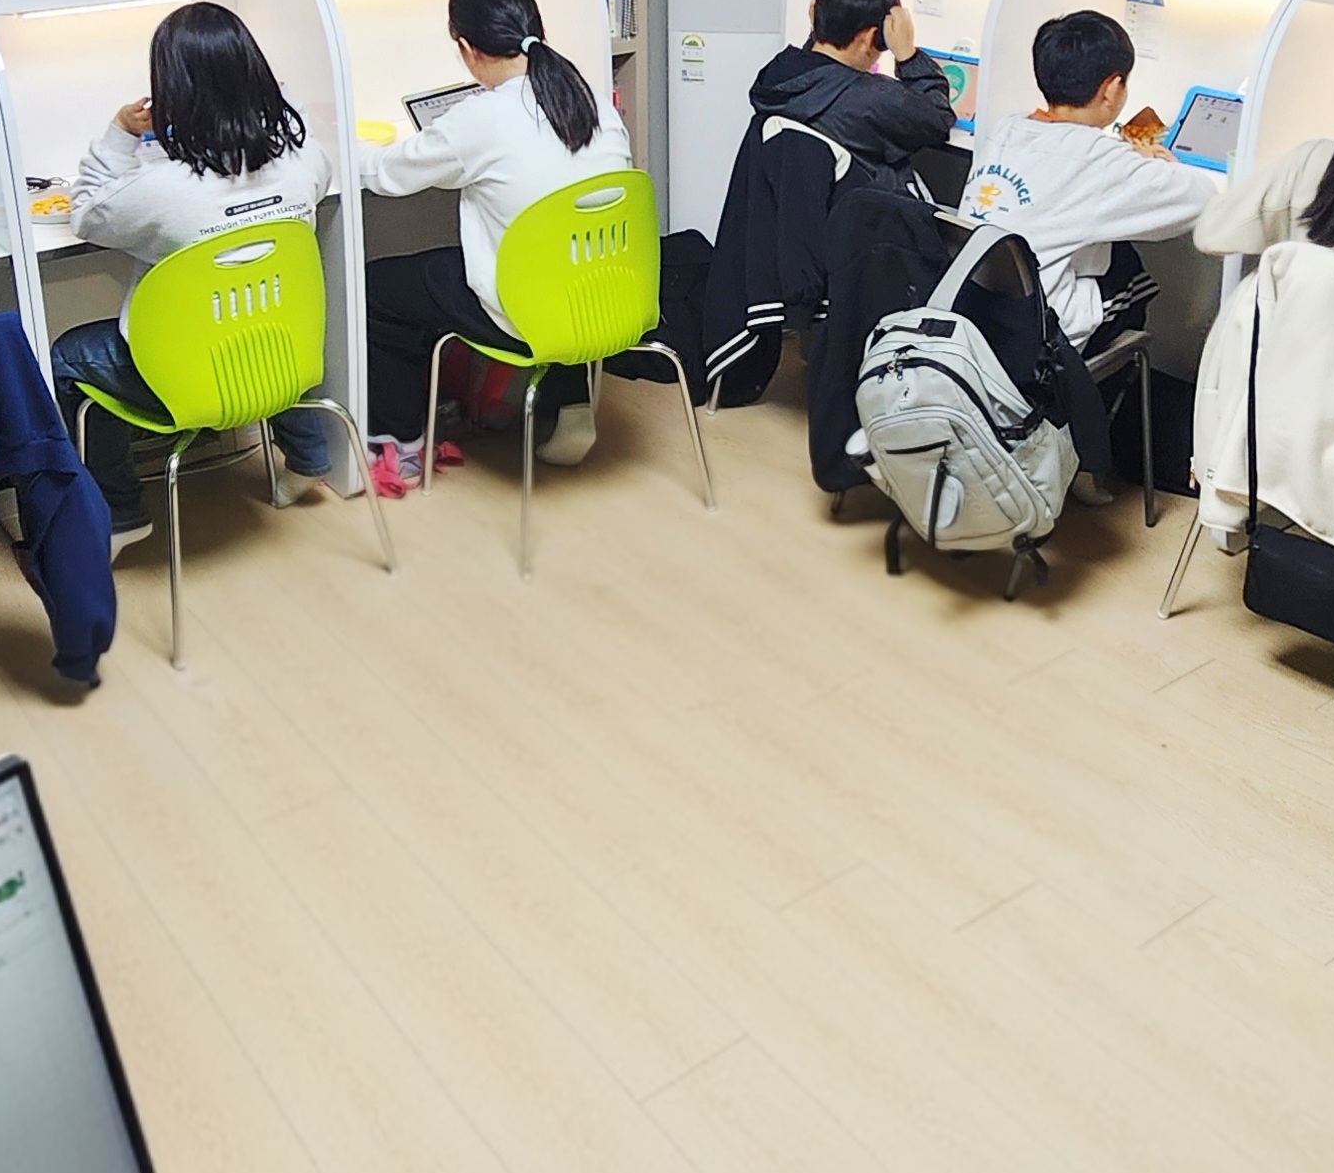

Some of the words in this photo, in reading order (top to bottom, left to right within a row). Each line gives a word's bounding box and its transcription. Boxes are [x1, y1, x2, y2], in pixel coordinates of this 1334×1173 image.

[987, 164, 1031, 205] BALANCE
[199, 221, 238, 235] THROUGH
[239, 216, 252, 226] THE
